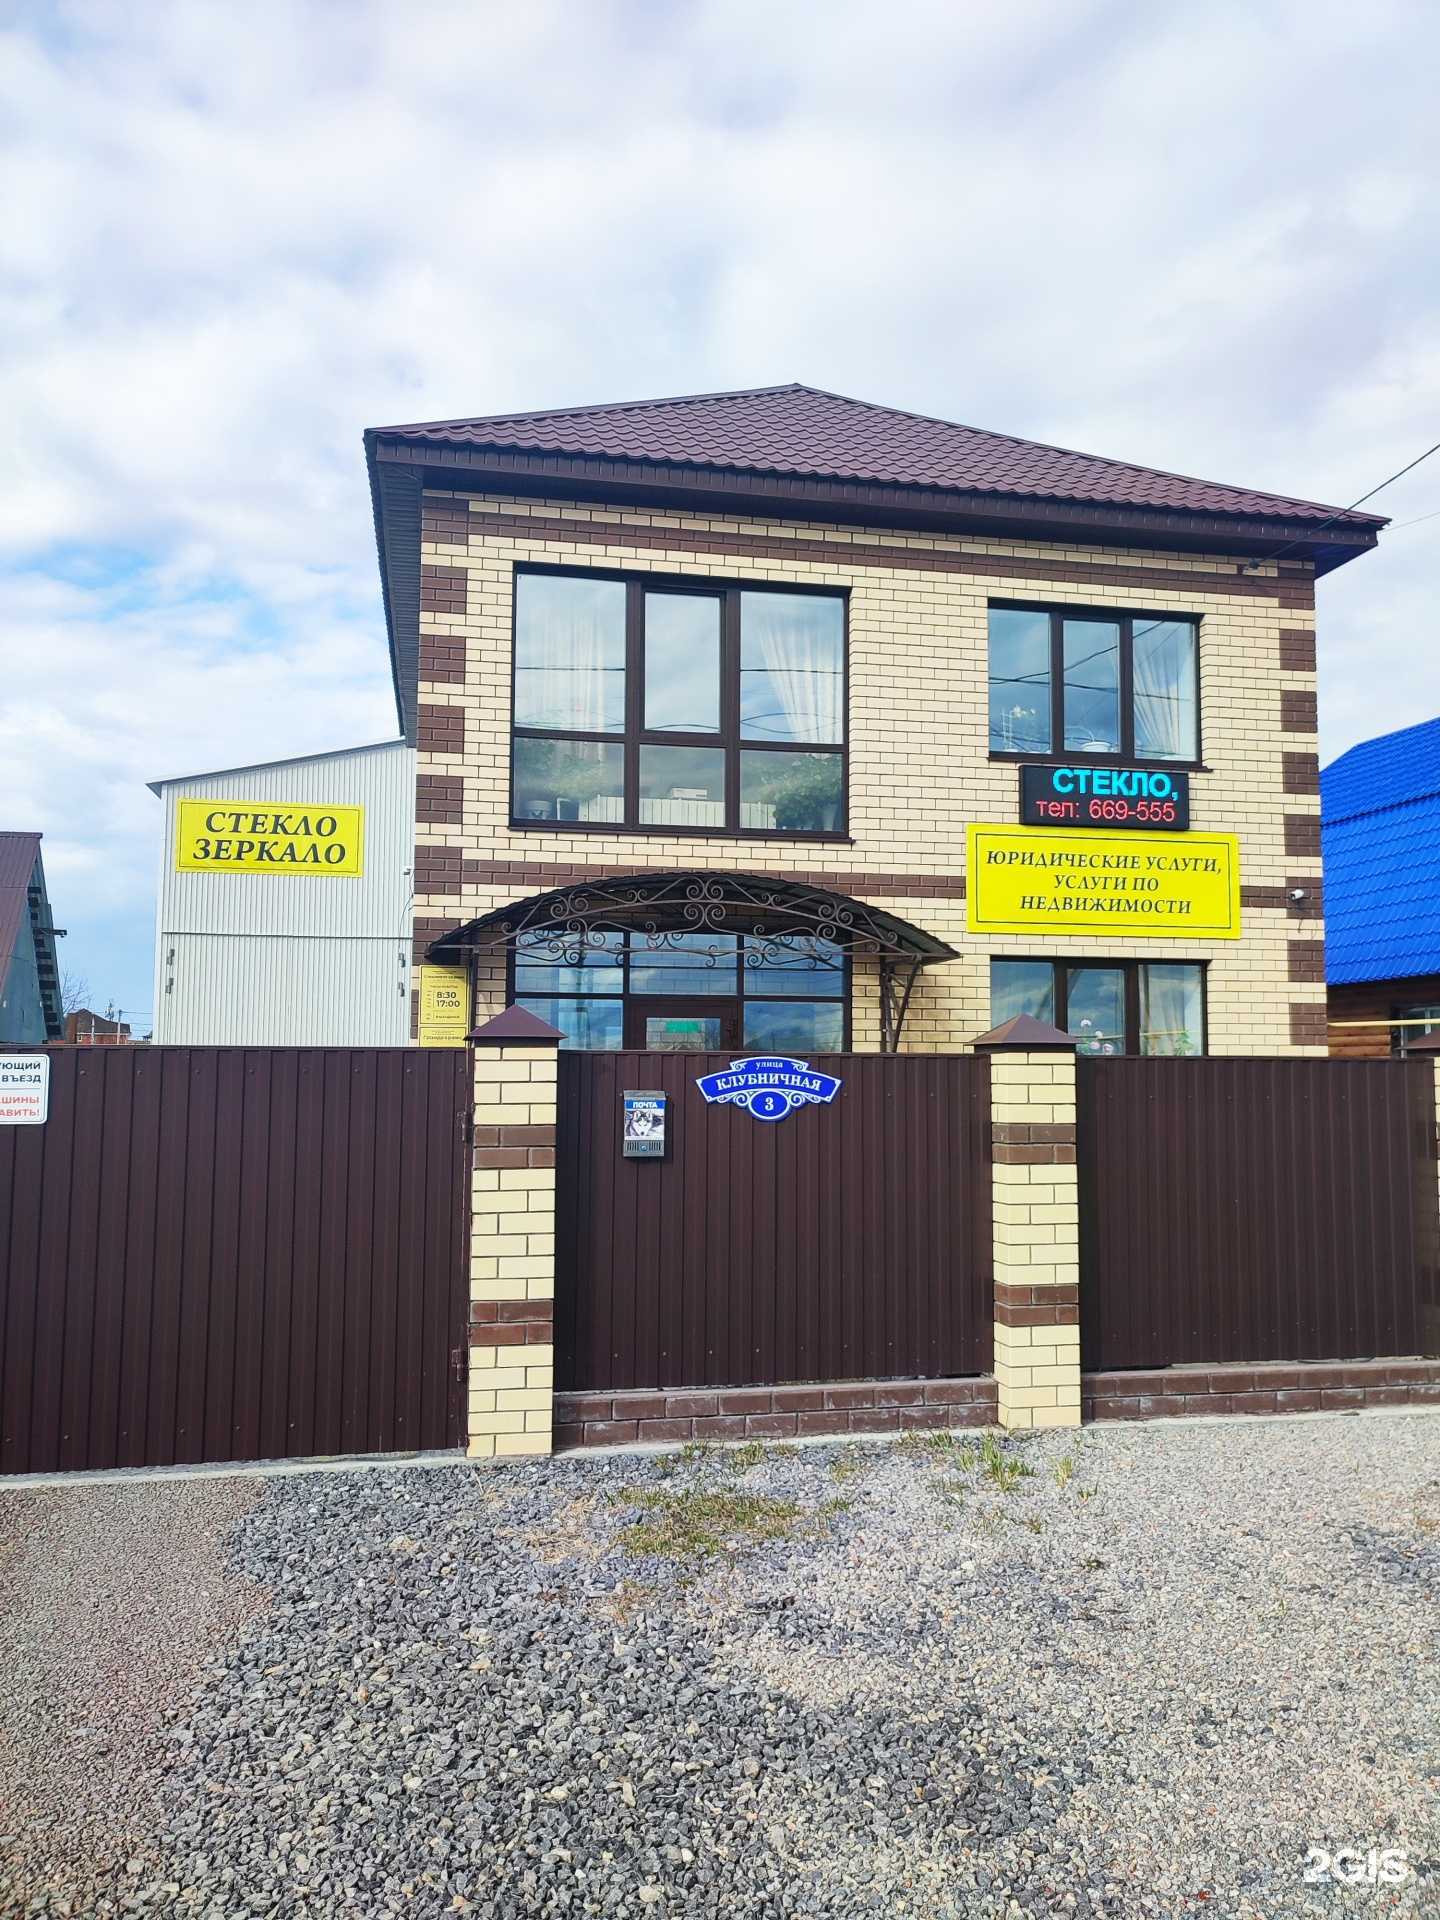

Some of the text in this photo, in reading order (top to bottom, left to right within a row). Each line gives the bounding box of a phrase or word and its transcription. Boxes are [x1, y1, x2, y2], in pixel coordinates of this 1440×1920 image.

[1053, 769, 1179, 801] СТЕКЛО,
[1036, 799, 1176, 822] тел: 669-555
[205, 811, 337, 837] СТЕКЛО
[192, 838, 346, 865] ЗЕРКАЛО
[985, 850, 1222, 874] ЮРИДИЧЕСКИЕ УСЛУГИ,
[1053, 874, 1159, 892] УСЛУГИ ПО
[1019, 895, 1192, 914] НЕДВИЖИМОСТИ
[436, 991, 457, 999] 8:30
[436, 1000, 460, 1008] 17:00
[0, 1061, 41, 1071] ЮЩИЙ
[755, 1061, 784, 1070] улица
[1, 1074, 41, 1083] ВЪЕЗД
[716, 1073, 822, 1091] КЛУБНИЧНАЯ
[0, 1096, 40, 1104] ШИНЫ
[632, 1101, 658, 1109] ПОЧТА
[764, 1097, 774, 1111] 3
